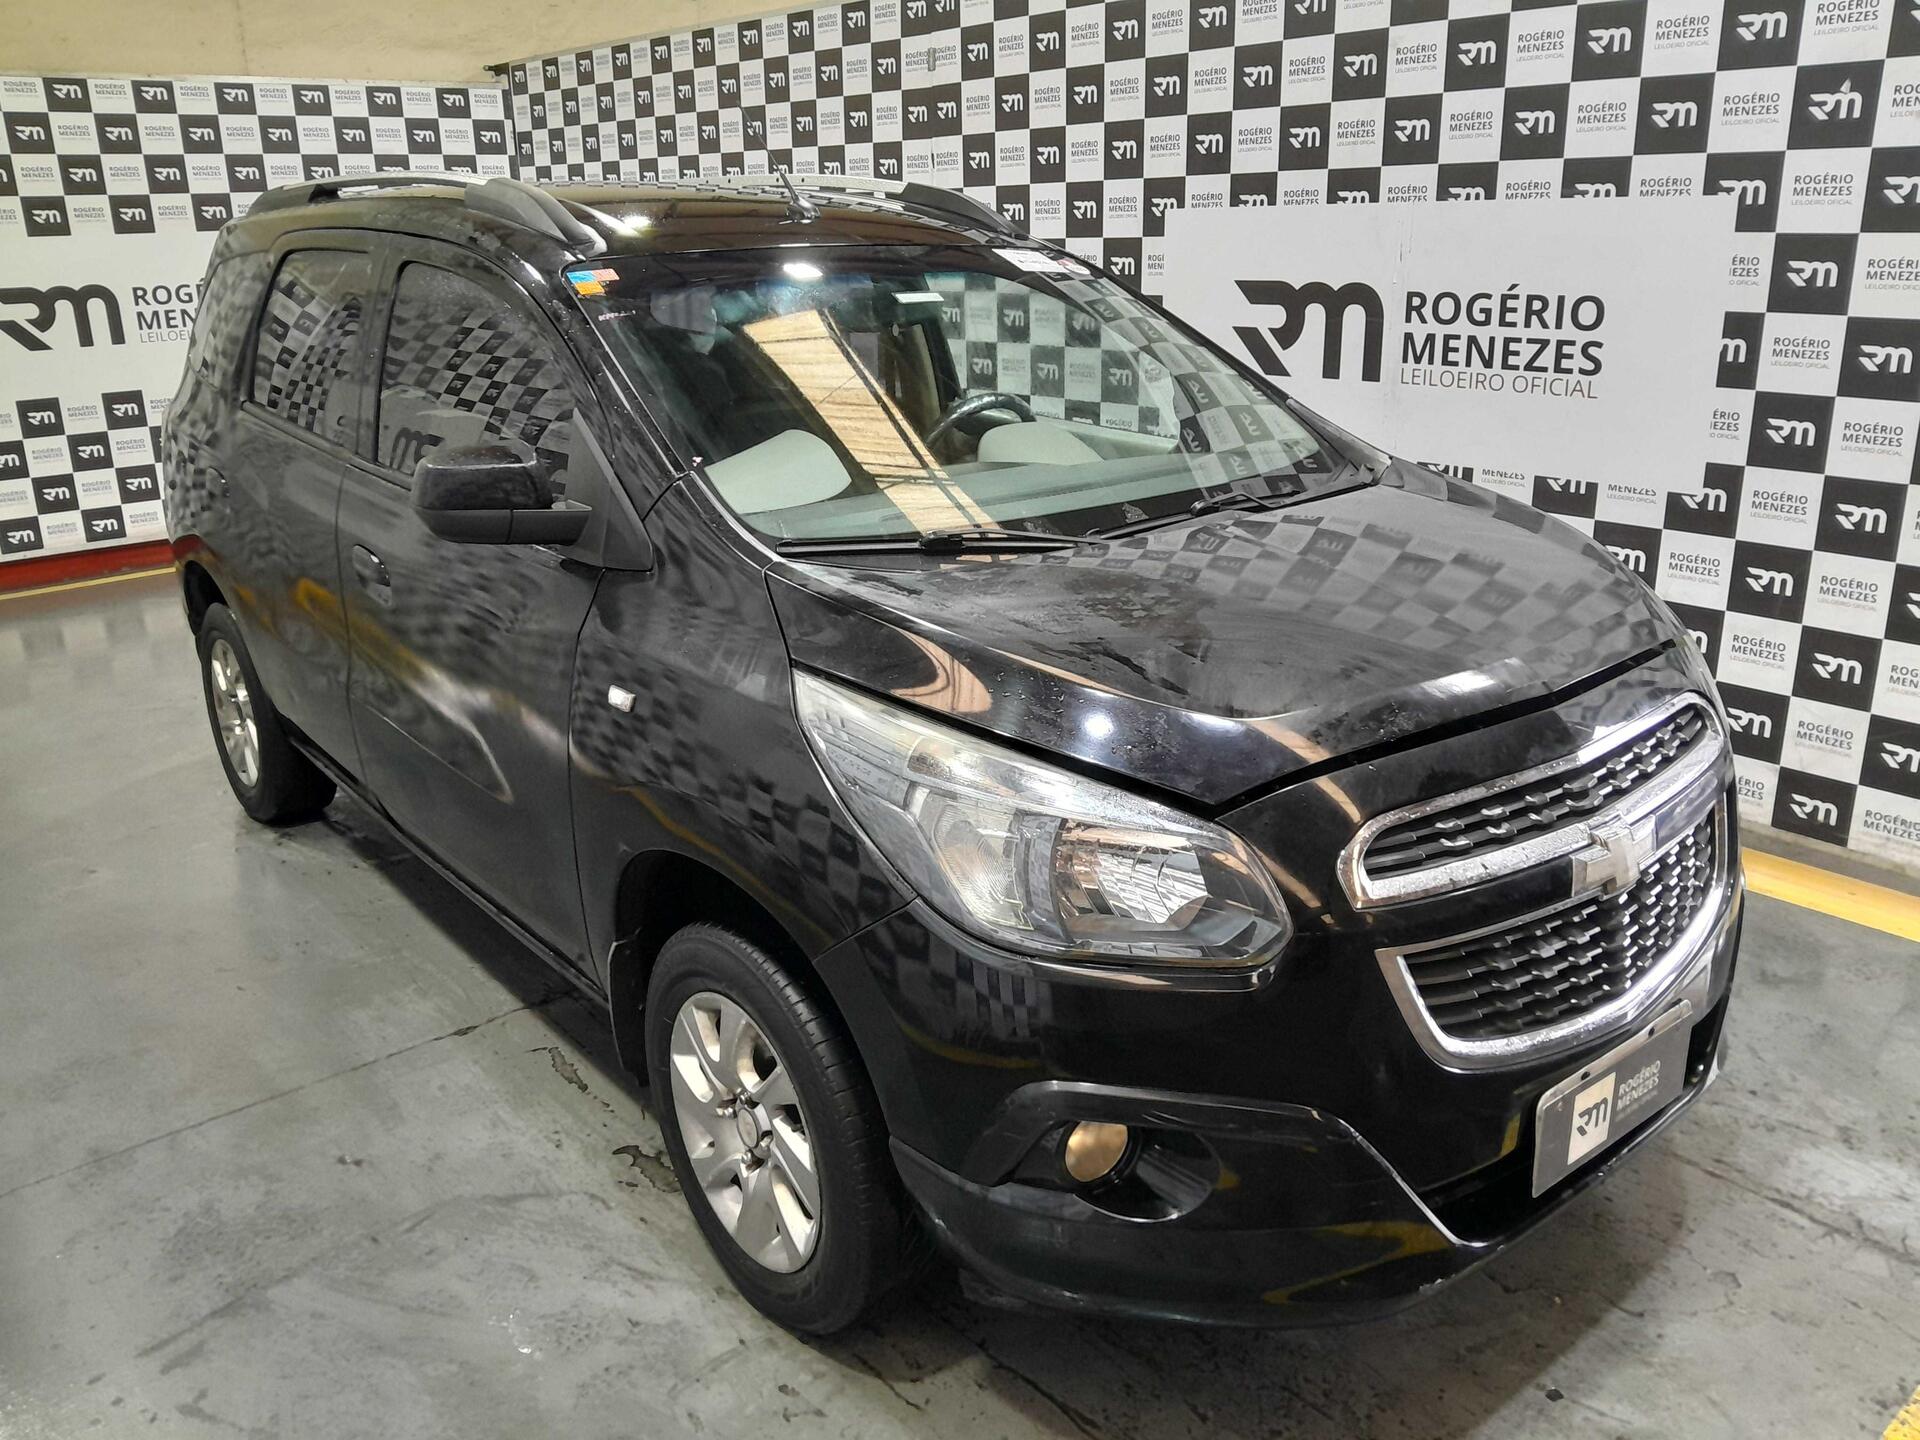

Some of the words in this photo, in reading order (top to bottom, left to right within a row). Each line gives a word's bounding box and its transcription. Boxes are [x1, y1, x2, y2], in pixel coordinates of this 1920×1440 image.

[1152, 8, 1183, 21] ROGÉRIO
[1242, 4, 1278, 18] MENEZES
[1152, 18, 1183, 30] MENEZES
[1656, 15, 1710, 29] ROGÉRIO
[1815, 10, 1878, 26] MENEZES
[1517, 30, 1565, 42] ROGÉRIO
[1655, 26, 1709, 40] MENEZES
[1396, 43, 1437, 56] ROGÉRIO
[1517, 41, 1564, 53] MENEZES
[1289, 56, 1326, 68] ROGÉRIO
[1395, 54, 1437, 66] MENEZES
[1194, 67, 1227, 78] ROGÉRIO
[1289, 65, 1326, 77] MENEZES
[1194, 75, 1227, 87] MENEZES
[1723, 92, 1780, 105] ROGÉRIO
[1577, 102, 1627, 114] ROGÉRIO
[1722, 104, 1779, 116] MENEZES
[1450, 111, 1493, 122] ROGÉRIO
[1577, 113, 1626, 124] MENEZES
[1337, 119, 1376, 129] ROGÉRIO
[1449, 121, 1493, 132] MENEZES
[1238, 126, 1272, 137] ROGÉRIO
[1337, 129, 1376, 139] MENEZES
[1150, 133, 1180, 144] ROGÉRIO
[1238, 136, 1272, 146] MENEZES
[1150, 142, 1180, 152] MENEZES
[1640, 176, 1691, 187] ROGÉRIO
[1794, 172, 1854, 185] ROGÉRIO
[1387, 184, 1428, 195] ROGÉRIO
[1505, 180, 1551, 191] ROGÉRIO
[1793, 186, 1852, 197] MENEZES
[1109, 196, 1137, 204] ROGÉRIO
[1191, 192, 1223, 201] ROGÉRIO
[1284, 189, 1319, 199] ROGÉRIO
[1109, 204, 1137, 213] MENEZES
[1868, 257, 1920, 269] ROGÉRI
[1404, 284, 1604, 331] ROGÉRIO
[1773, 337, 1830, 348] ROGÉRIO
[1401, 332, 1604, 376] MENEZES
[1772, 348, 1829, 360] MENEZES
[1401, 368, 1504, 391] LEILOEIRO
[1513, 375, 1598, 399] OFICIAL
[1844, 421, 1904, 436] ROGÉRIO
[1842, 433, 1903, 447] MENEZES
[1753, 490, 1808, 505] ROGÉRIO
[1752, 500, 1808, 516] MENEZES
[1670, 551, 1720, 568] ROGÉRIO
[1668, 562, 1720, 578] MENEZES
[1821, 575, 1878, 592] ROGÉRIO
[1819, 586, 1877, 603] MENEZES
[1733, 634, 1786, 652] ROGÉRIO
[1731, 644, 1785, 662] MENEZES
[1798, 720, 1853, 740] ROGÉRIO
[1796, 730, 1853, 750] MENEZES
